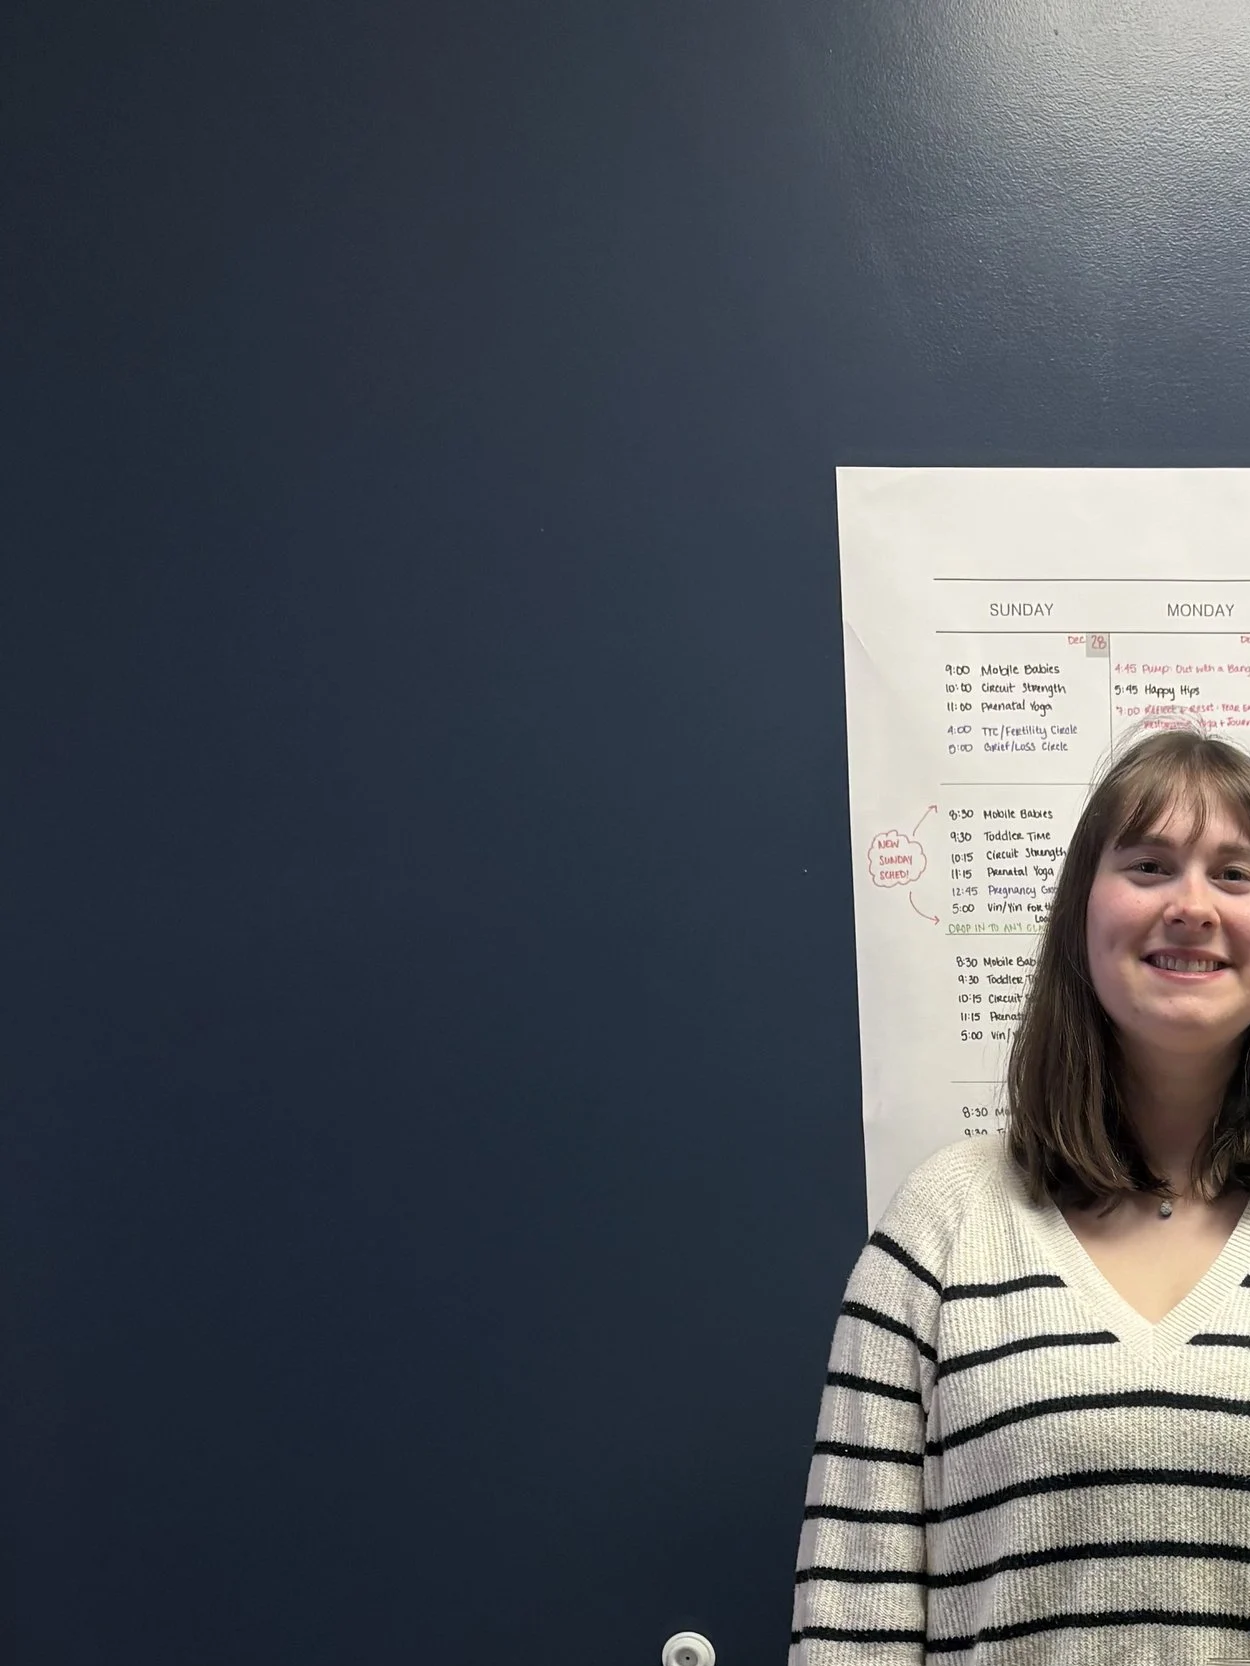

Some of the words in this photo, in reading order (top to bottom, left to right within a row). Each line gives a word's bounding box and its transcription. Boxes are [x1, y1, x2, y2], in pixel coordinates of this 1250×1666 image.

[990, 603, 1053, 616] SUNDAY
[1168, 604, 1234, 617] MONDAY
[1091, 635, 1107, 649] 28
[945, 665, 970, 675] 9:00
[981, 664, 1019, 676] Mobile
[1024, 664, 1059, 675] Babies
[946, 683, 972, 693] 10:00
[982, 683, 1015, 692] Circuit
[1023, 683, 1066, 698] Strength
[1145, 684, 1175, 701] Happy
[1181, 685, 1199, 698] Hips
[878, 840, 899, 849] NEW
[880, 855, 912, 865] SUNDAY
[880, 870, 909, 880] SCHED!
